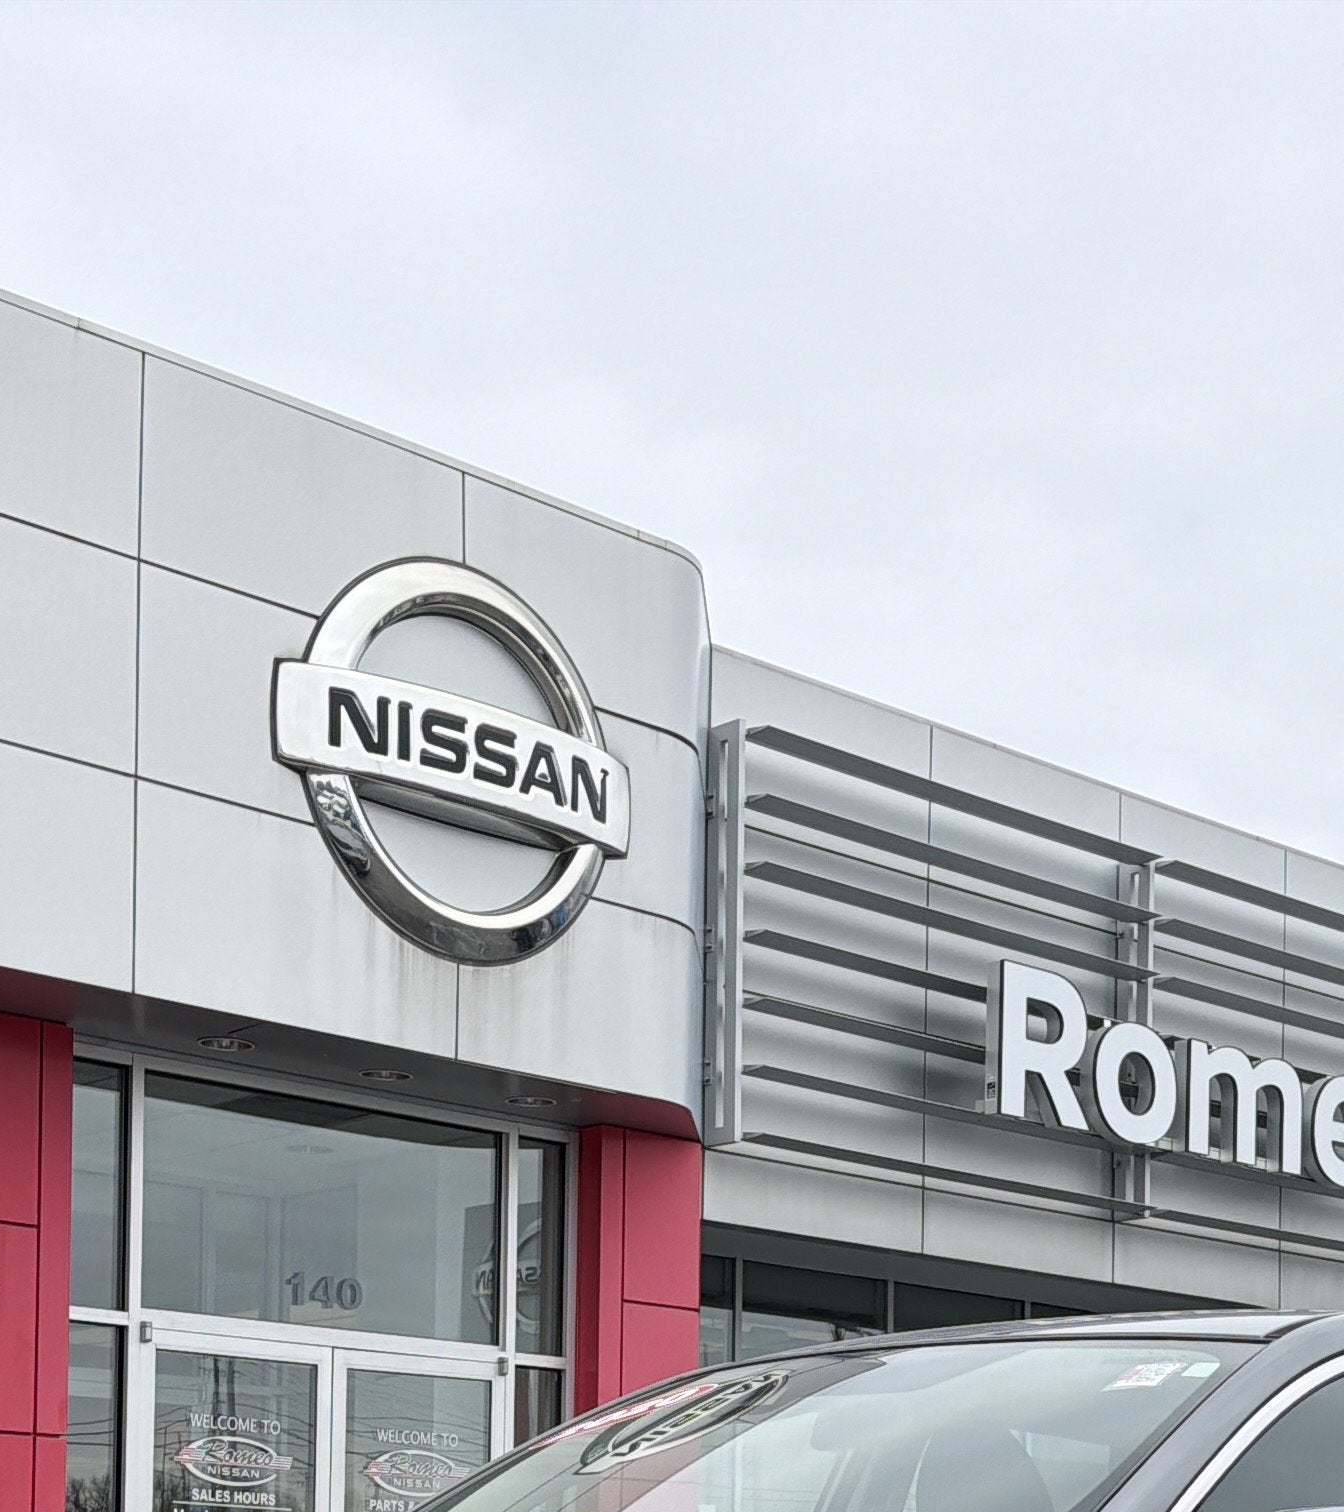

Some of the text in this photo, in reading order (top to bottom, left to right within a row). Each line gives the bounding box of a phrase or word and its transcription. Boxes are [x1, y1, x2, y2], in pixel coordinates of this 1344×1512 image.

[327, 686, 609, 825] NISSAN
[285, 1271, 363, 1311] 140
[190, 1413, 281, 1434] WELCOME TO
[376, 1428, 459, 1447] WELCOME TO
[201, 1438, 274, 1467] Romeo
[207, 1465, 260, 1479] NISSAN
[388, 1453, 453, 1478] Romeo
[393, 1478, 440, 1489] NISSAN
[191, 1488, 276, 1506] SALES HOURS
[369, 1500, 405, 1512] PARTS
